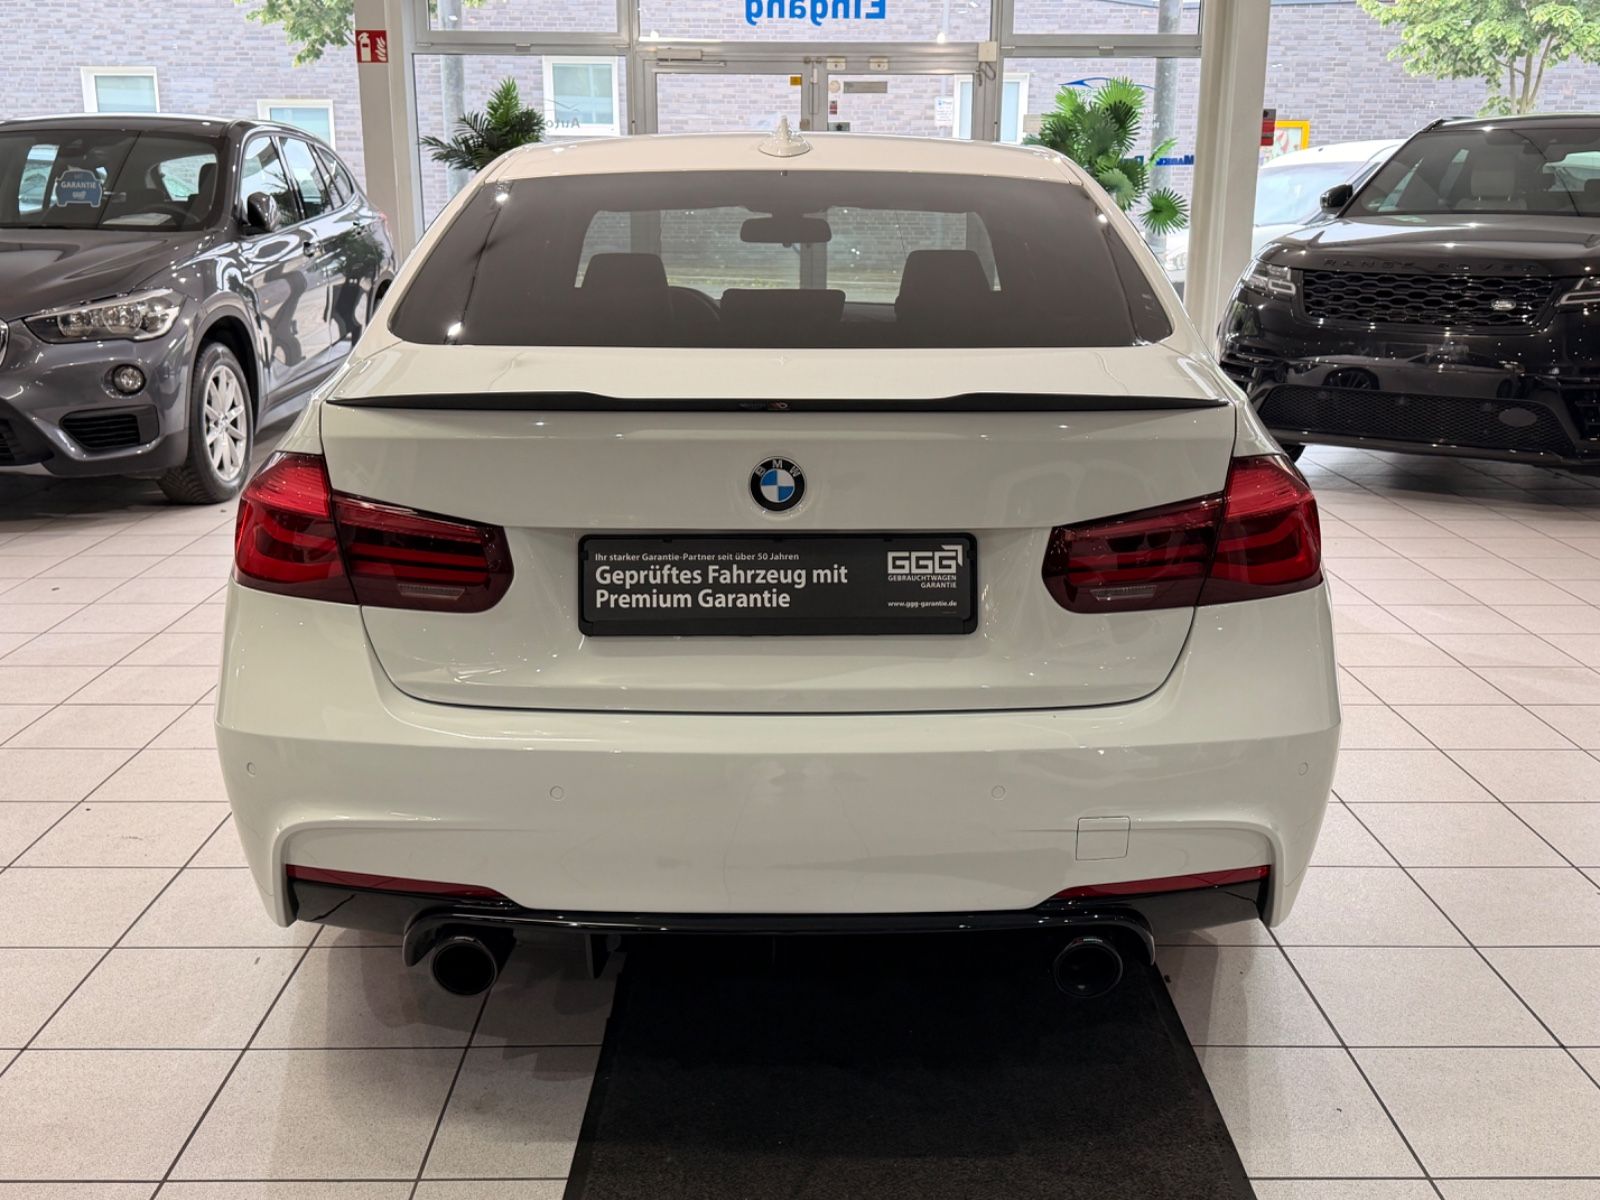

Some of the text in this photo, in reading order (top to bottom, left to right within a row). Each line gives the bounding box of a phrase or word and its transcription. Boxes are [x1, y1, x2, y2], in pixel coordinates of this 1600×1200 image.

[60, 181, 97, 190] GARANTIE
[754, 459, 802, 478] BMW
[595, 552, 800, 561] Ihr starker Garantie-Partner seit über 50 Jahren
[887, 551, 957, 574] GGG
[595, 564, 848, 589] Geprüftes Fahrzeug mit
[595, 588, 791, 608] Premium Garantie
[887, 600, 958, 608] www.ggg-garantie.de
